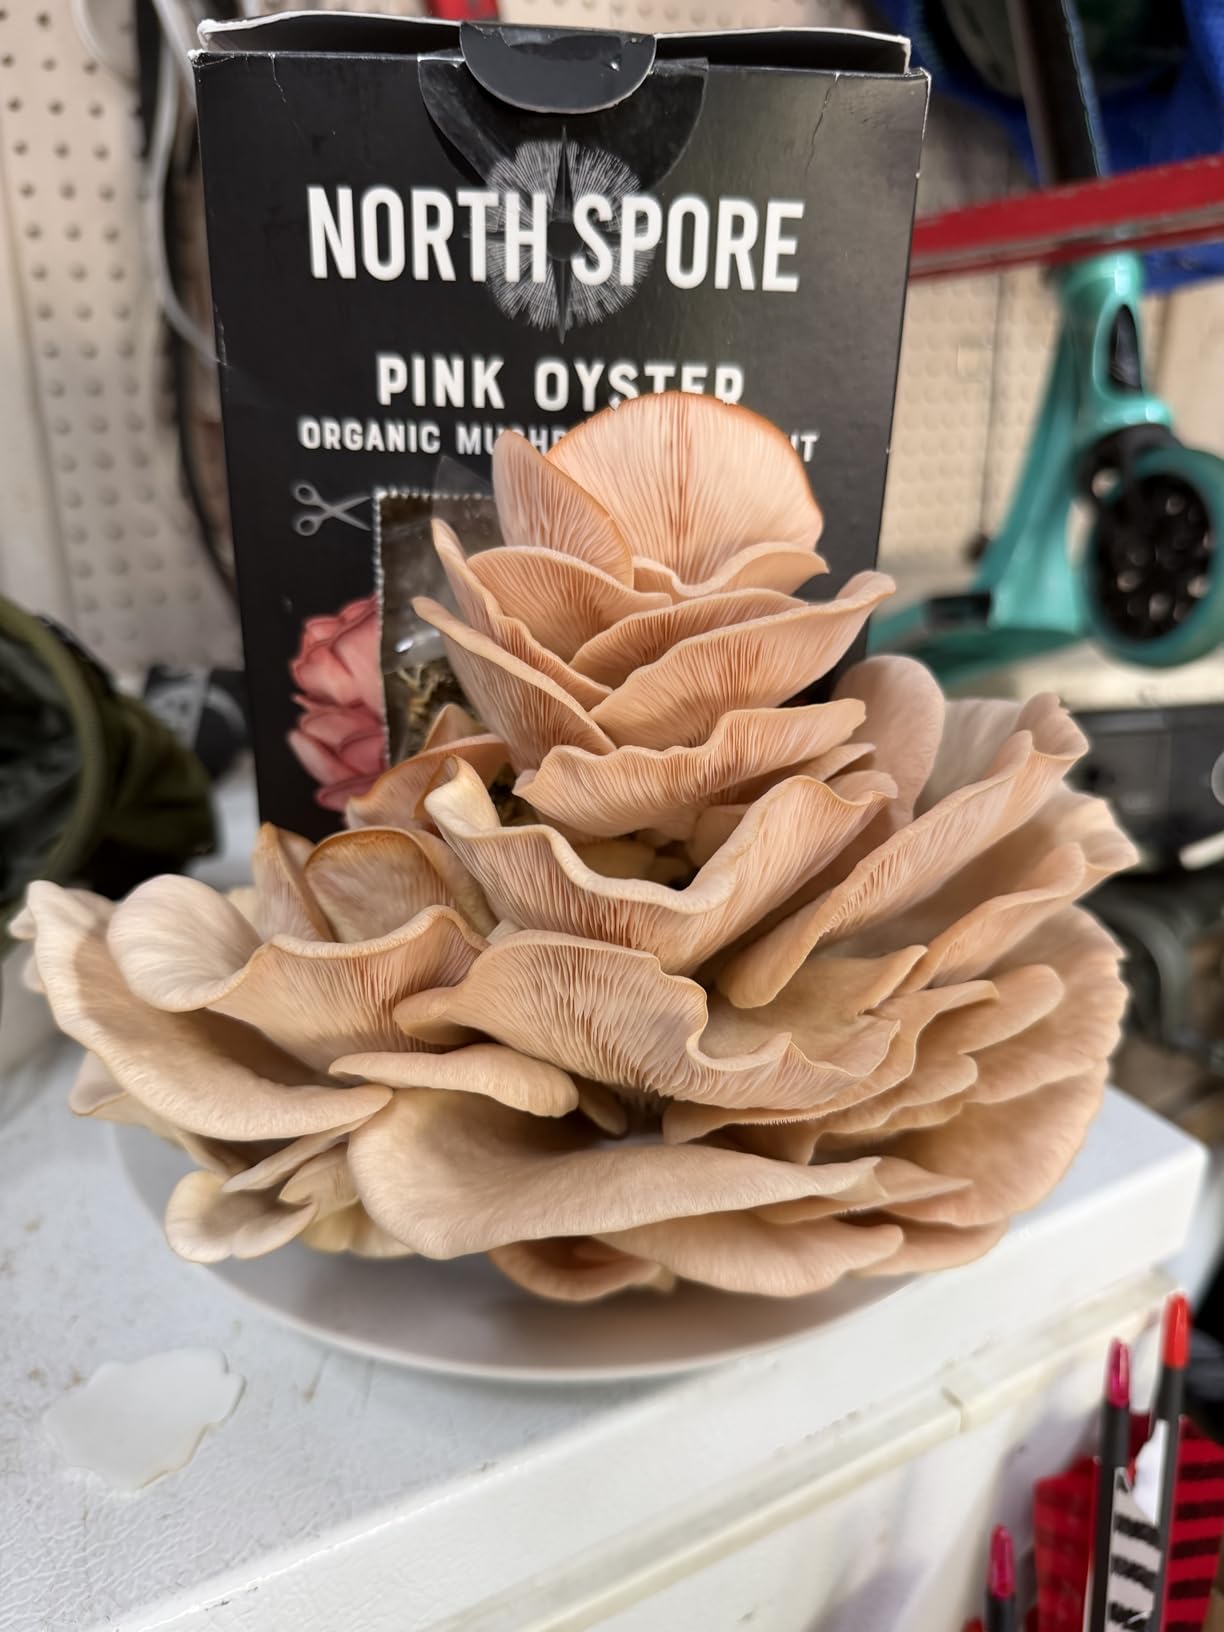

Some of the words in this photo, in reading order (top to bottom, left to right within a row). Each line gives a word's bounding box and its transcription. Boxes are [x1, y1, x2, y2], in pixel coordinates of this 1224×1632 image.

[308, 185, 548, 283] NORTH
[571, 193, 805, 292] SPORE
[377, 354, 505, 409] PINK
[534, 359, 744, 412] OYSTER
[298, 417, 441, 454] ORGANIC
